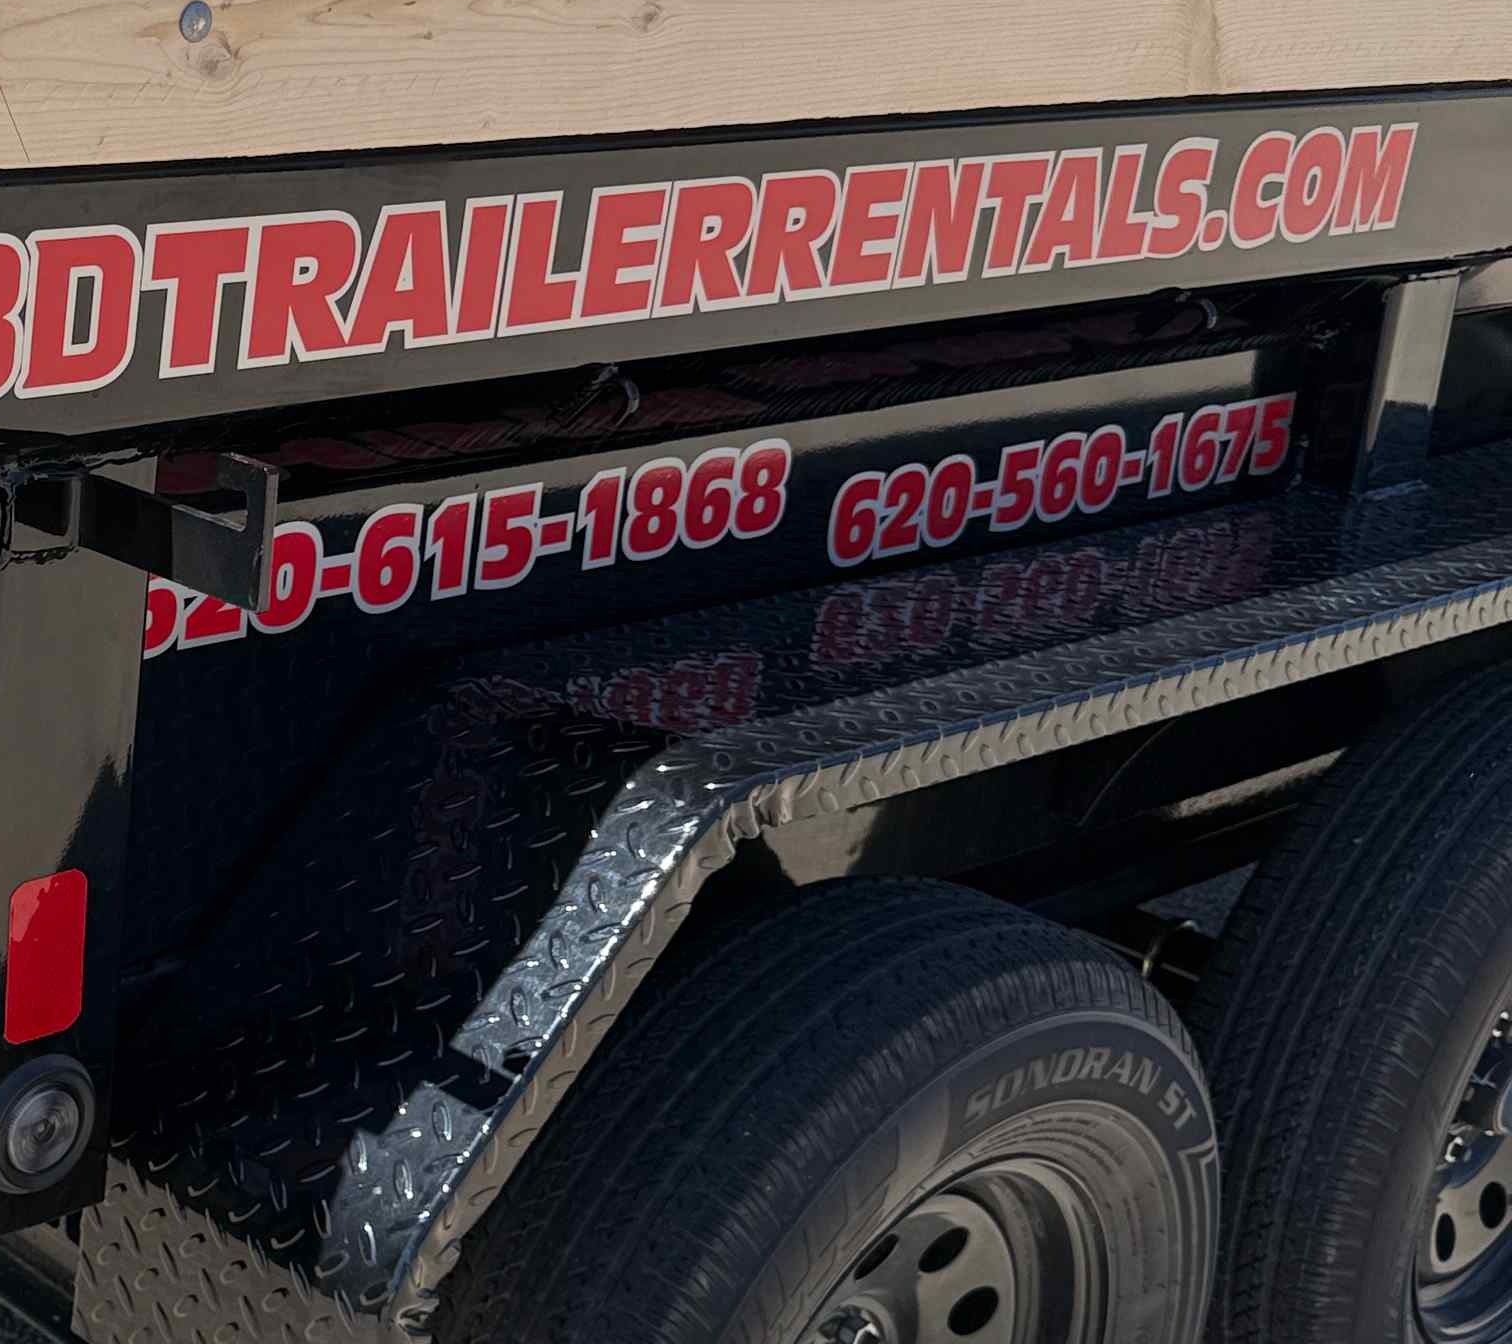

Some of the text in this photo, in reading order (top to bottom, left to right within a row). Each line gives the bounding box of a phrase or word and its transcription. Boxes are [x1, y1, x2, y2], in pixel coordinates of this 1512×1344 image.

[827, 391, 1297, 568] 620-560-1675
[965, 1047, 1198, 1130] SONORAN ST
